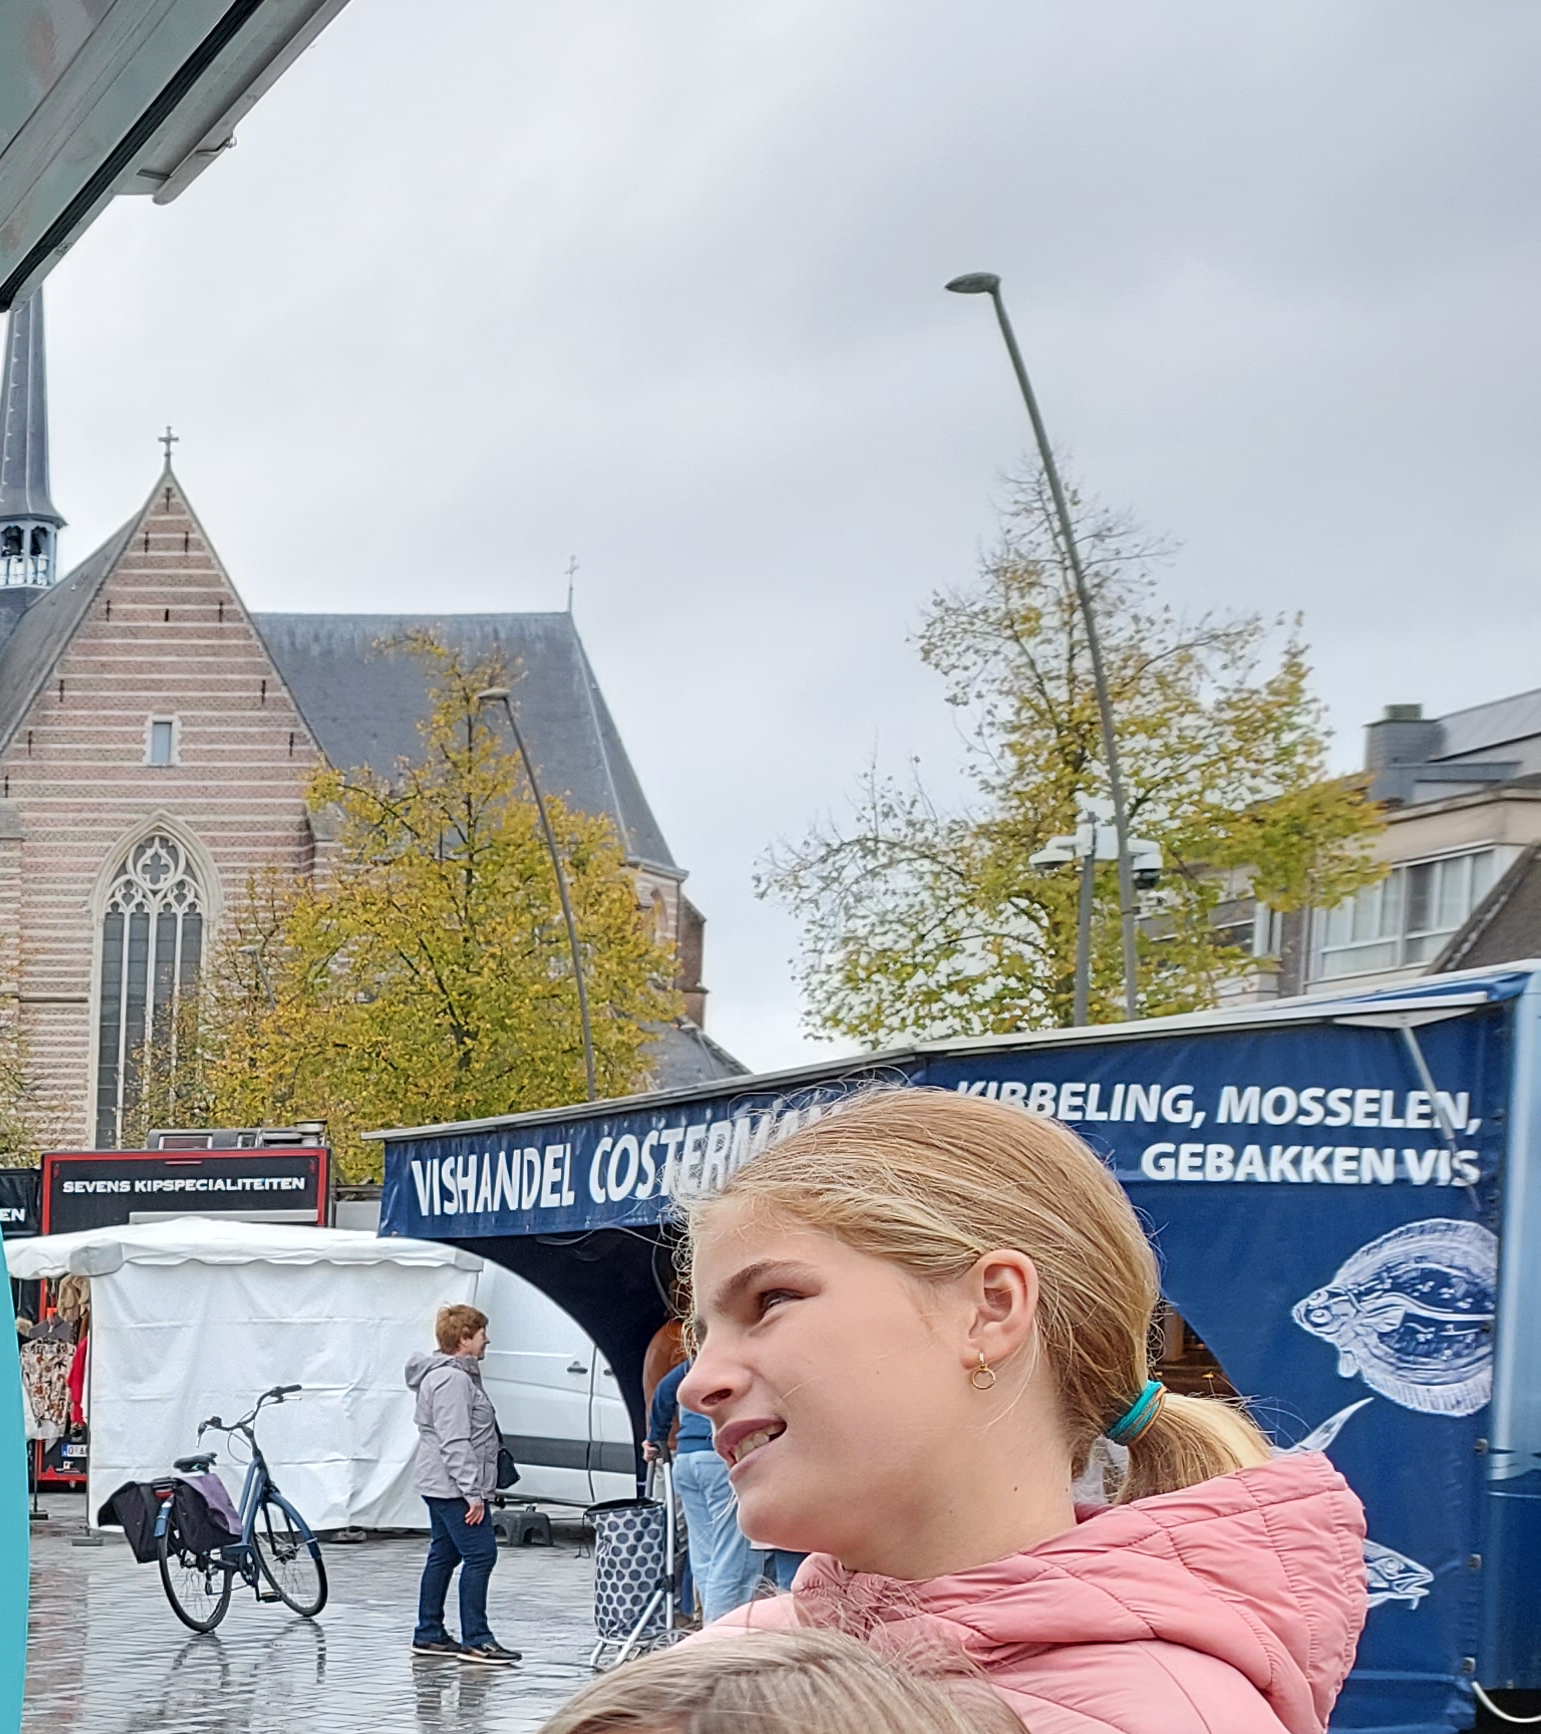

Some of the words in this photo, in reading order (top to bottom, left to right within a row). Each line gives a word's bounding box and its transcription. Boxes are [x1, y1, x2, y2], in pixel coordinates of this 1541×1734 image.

[1218, 1086, 1483, 1134] MOSSELEN,
[411, 1143, 575, 1218] VISHANDEL
[588, 1105, 844, 1204] COSTERM
[1140, 1142, 1393, 1182] GEBAKKEN
[1393, 1149, 1481, 1188] VIS
[62, 1180, 131, 1193] SEVENS
[134, 1178, 305, 1192] KIPSPECIALITEITEN
